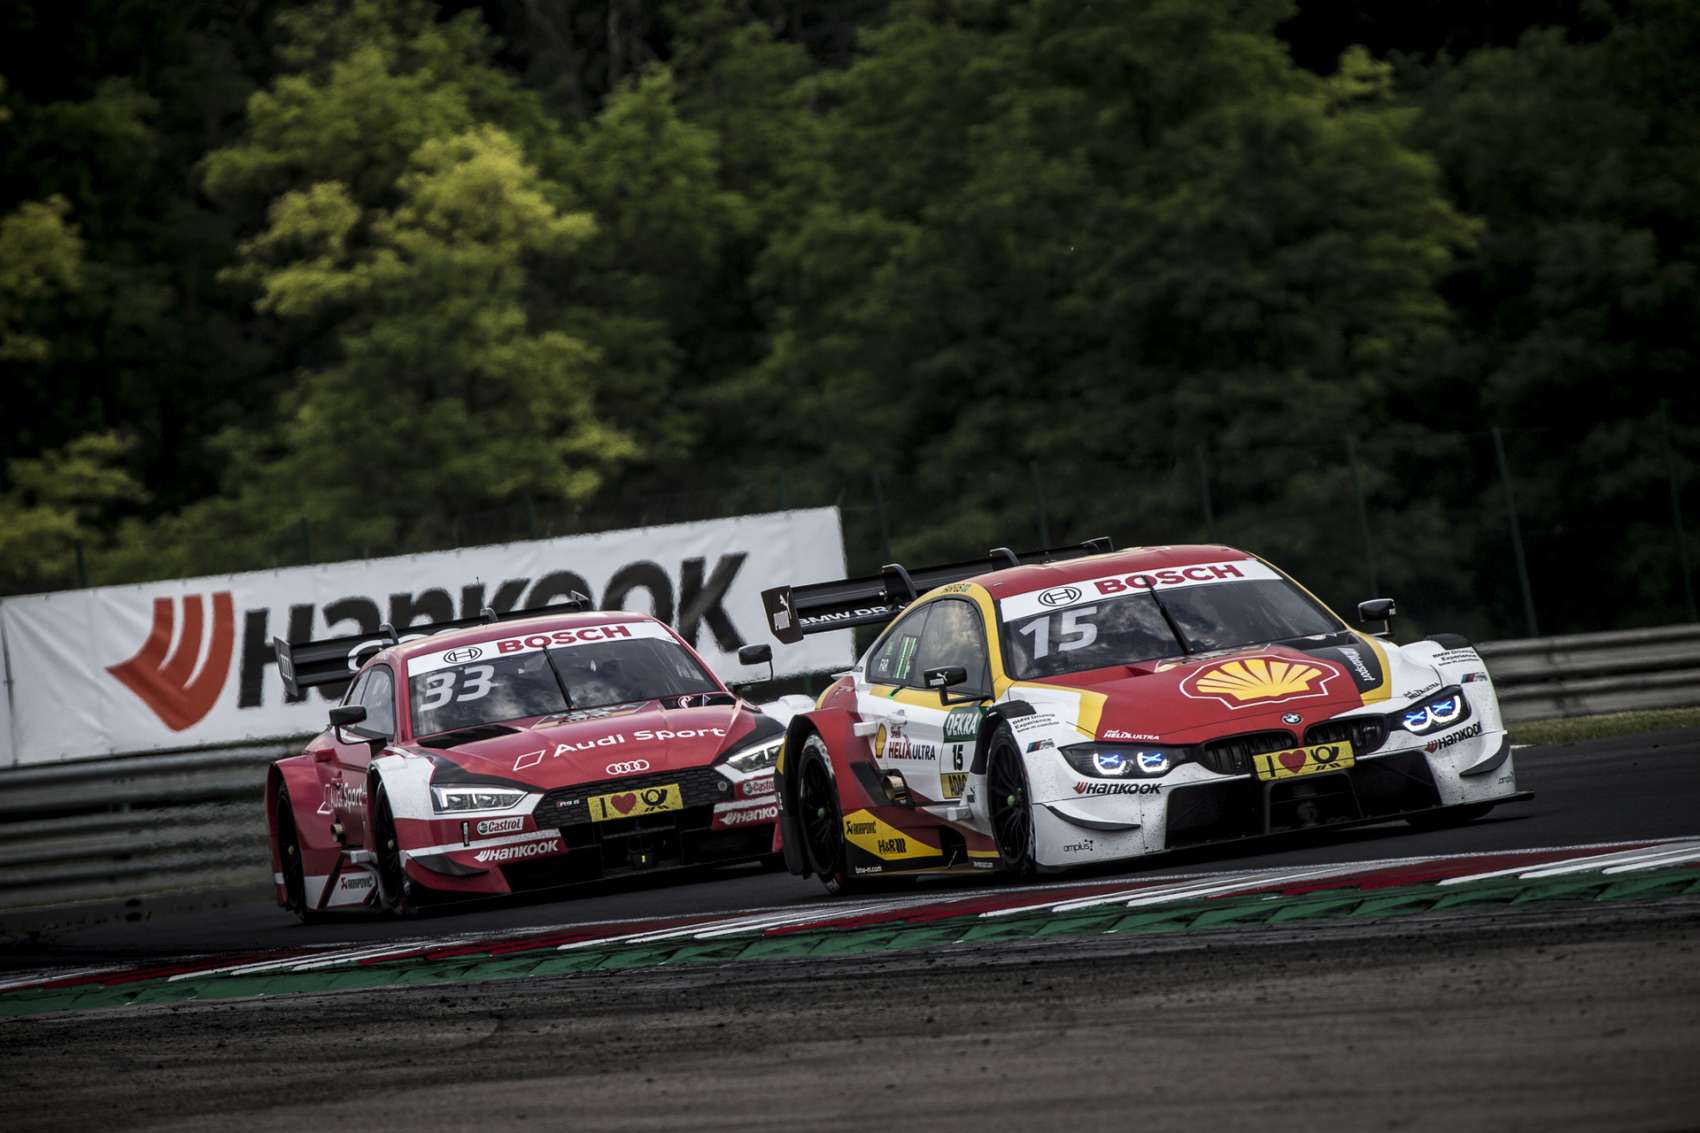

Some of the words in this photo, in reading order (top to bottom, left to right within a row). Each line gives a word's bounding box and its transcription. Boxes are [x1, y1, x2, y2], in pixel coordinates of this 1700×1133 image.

[1093, 564, 1245, 595] BOSCH
[497, 625, 632, 654] BOSCH
[1019, 606, 1098, 660] 15
[419, 664, 495, 712] 33
[945, 712, 980, 737] DEKRA
[553, 733, 625, 758] Audi
[633, 727, 727, 741] Sport
[888, 740, 912, 760] HELIX
[912, 744, 936, 761] ULTRA
[952, 744, 964, 771] 15
[1266, 755, 1275, 777] I
[488, 819, 521, 833] Castrol
